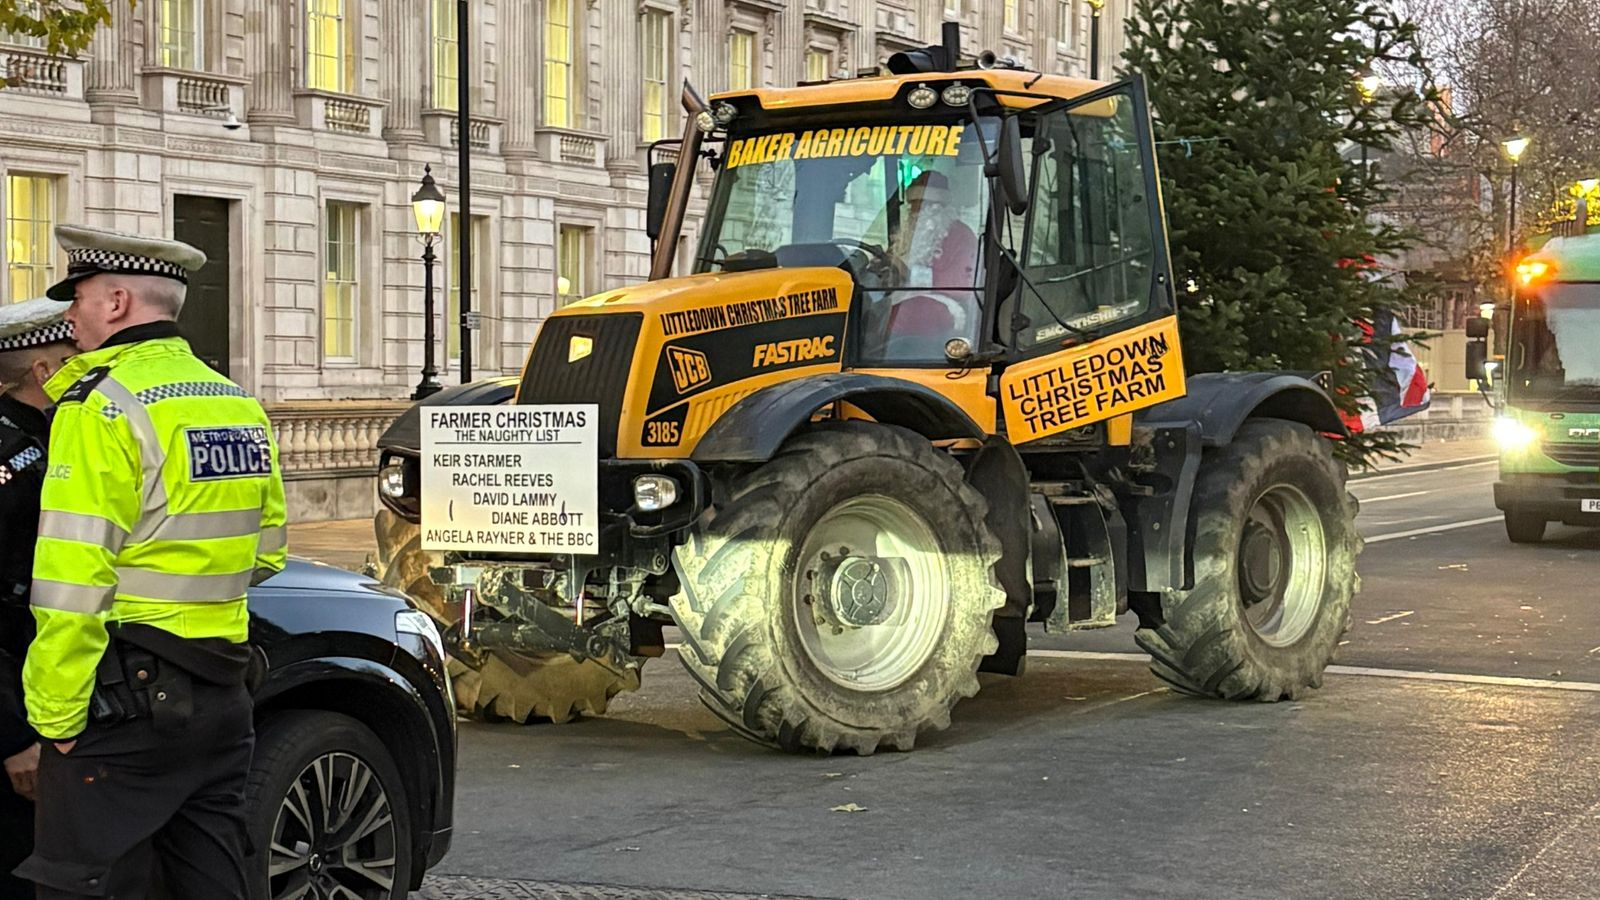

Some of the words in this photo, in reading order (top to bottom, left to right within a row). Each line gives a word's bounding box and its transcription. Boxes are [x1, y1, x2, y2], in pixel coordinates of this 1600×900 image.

[727, 133, 795, 169] BAKER
[794, 126, 964, 159] AGRICULTURE
[660, 306, 726, 336] LITTLEDOWN
[727, 296, 786, 325] CHRISTMAS
[787, 292, 811, 315] TREE
[812, 288, 838, 311] FARM
[1036, 301, 1139, 341] SMOTHSHIFT
[752, 335, 835, 368] FASTRAC
[1010, 332, 1168, 400] LITTLEDOWN
[672, 350, 708, 390] JCB
[1020, 357, 1163, 416] CHRISTMAS
[1025, 399, 1089, 433] TREE
[1096, 374, 1165, 411] FARM
[432, 413, 491, 428] FARMER
[496, 411, 586, 428] CHRISTMAS
[648, 422, 679, 443] 3185
[455, 430, 475, 441] THE
[479, 430, 533, 441] NAUGHTY
[536, 430, 560, 441] LIST
[193, 444, 271, 475] POLICE
[434, 454, 461, 467] KEIR
[464, 454, 522, 467] STARMER
[453, 473, 501, 486] RACHEL
[505, 474, 553, 487] REEVES
[474, 493, 508, 506] DAVID
[512, 493, 557, 506] LAMMY
[492, 512, 528, 525] DIANE
[532, 513, 583, 526] ABBOTT
[427, 530, 473, 543] ANGELA
[477, 532, 524, 544] RAYNER
[528, 533, 536, 544] &
[540, 533, 563, 545] THE
[568, 533, 593, 546] BBC
